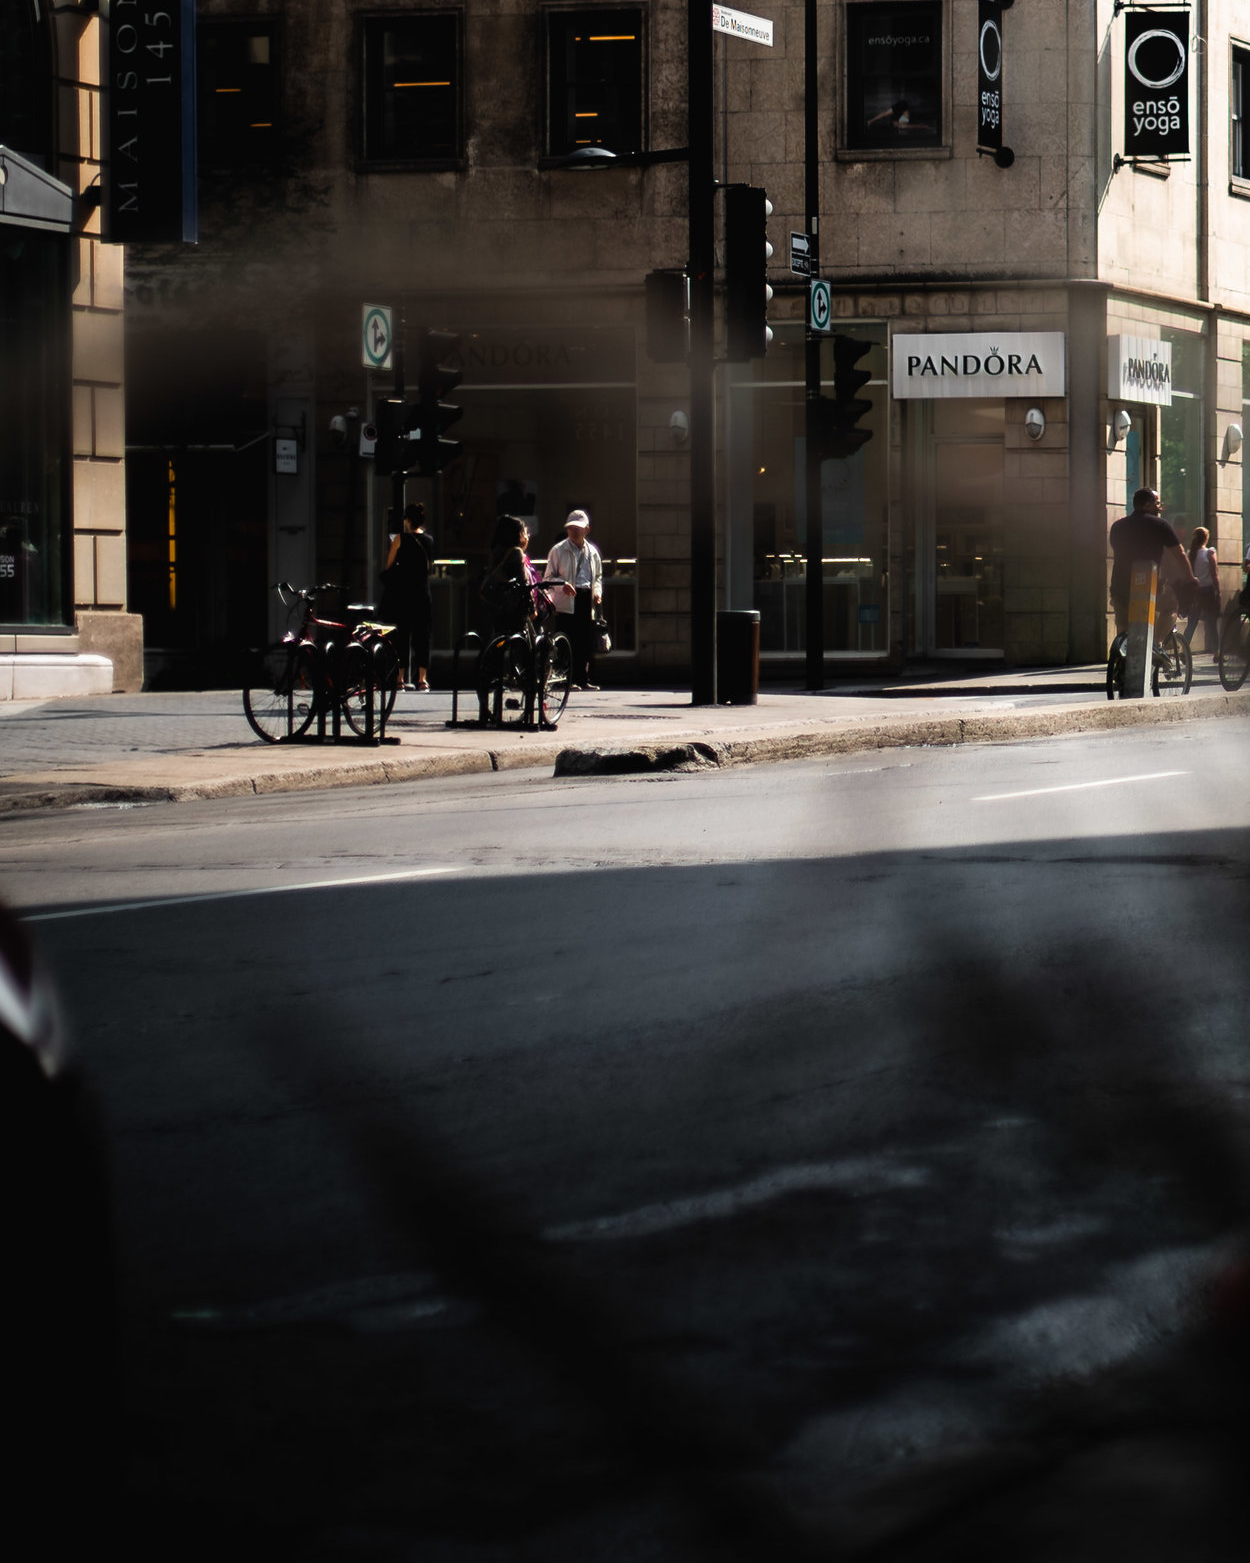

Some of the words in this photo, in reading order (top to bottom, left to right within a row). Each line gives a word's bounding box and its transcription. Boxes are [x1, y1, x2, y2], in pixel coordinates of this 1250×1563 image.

[720, 15, 730, 30] De
[730, 18, 770, 41] Maisonneuve
[981, 107, 1000, 129] yoga
[1133, 116, 1180, 136] yoga
[907, 354, 1043, 376] PANDORA
[1128, 356, 1170, 383] PANDORA
